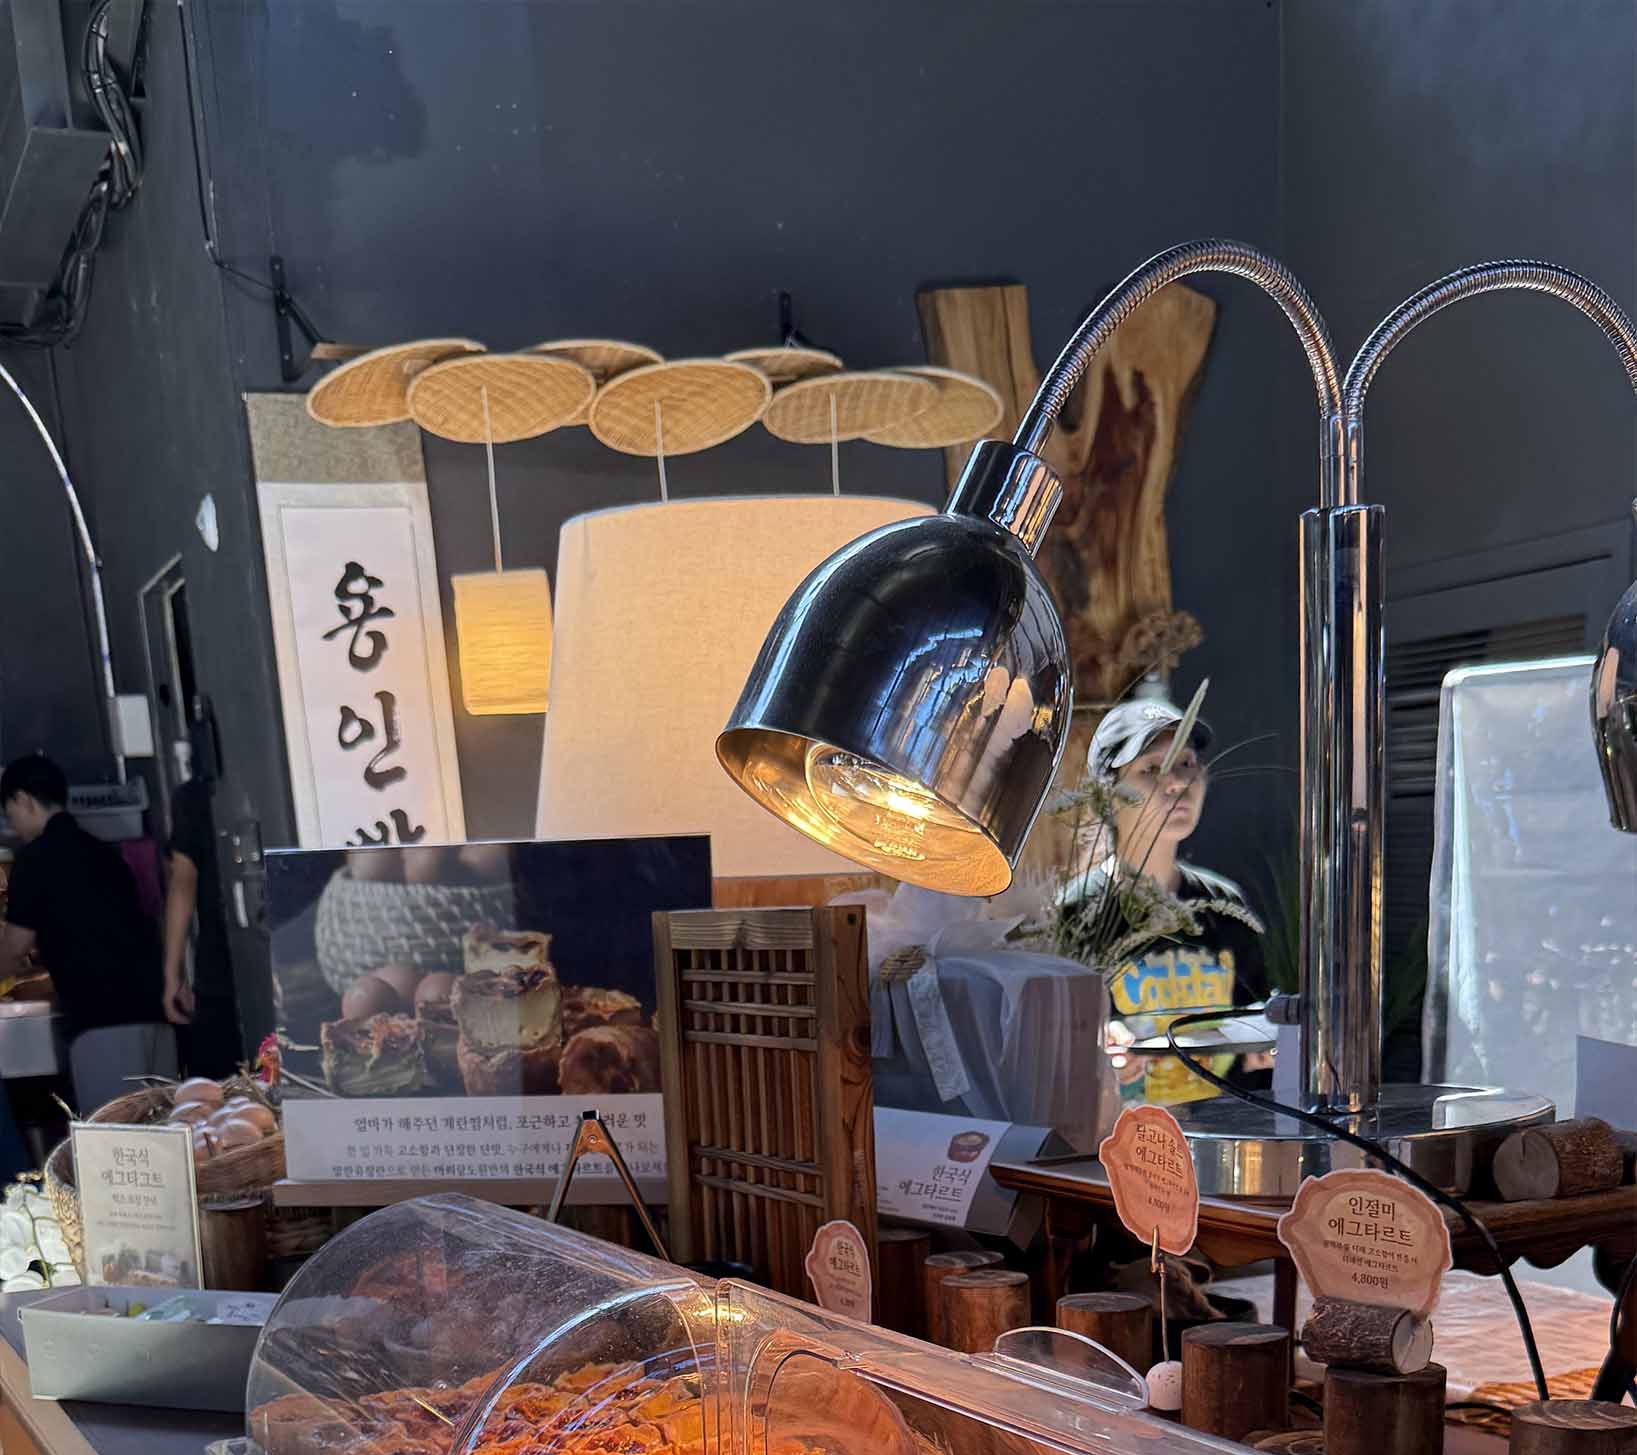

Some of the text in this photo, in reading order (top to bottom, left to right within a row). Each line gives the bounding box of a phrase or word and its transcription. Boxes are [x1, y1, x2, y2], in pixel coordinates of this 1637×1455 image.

[516, 1112, 569, 1130] 포근하고
[1136, 1124, 1166, 1149] 달고나
[112, 1147, 150, 1167] 한국식
[1136, 1146, 1184, 1179] 에그타르트
[932, 1165, 972, 1185] 한국식
[898, 1180, 963, 1202] 에그타르트
[1348, 1196, 1396, 1221] 인절미
[1328, 1217, 1414, 1247] 에그타르트
[1352, 1272, 1389, 1289] 4,800원
